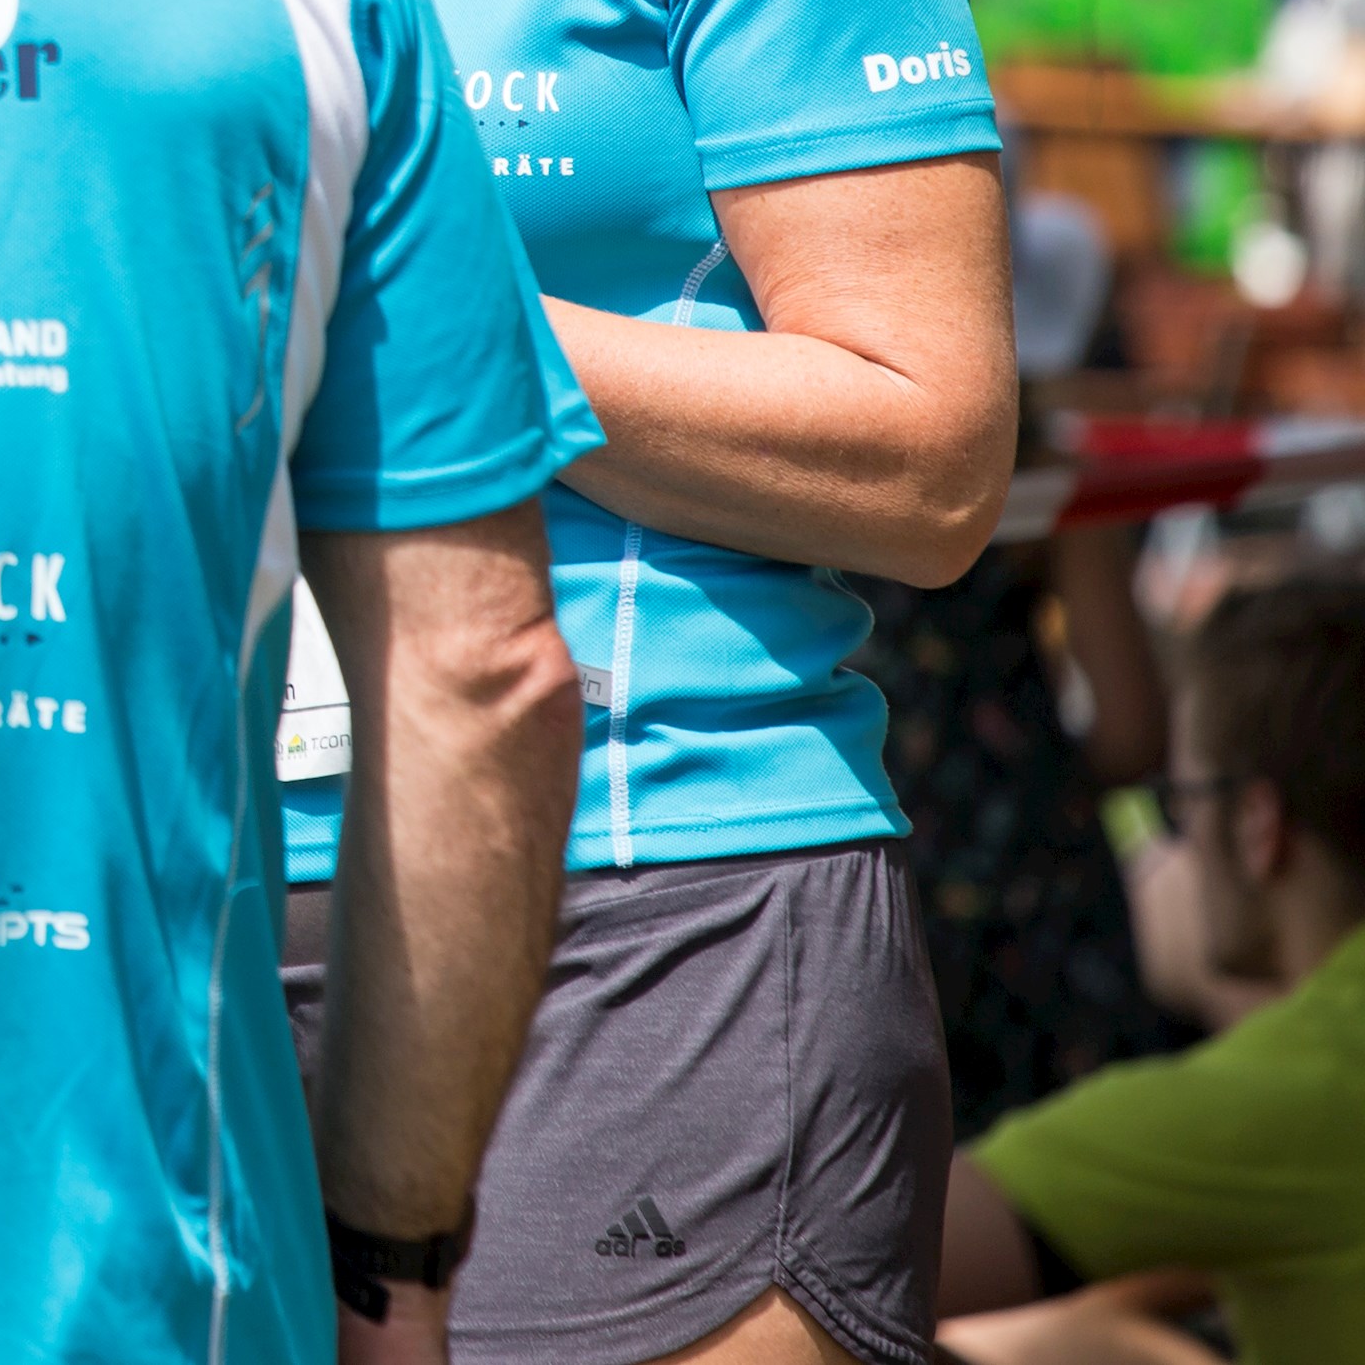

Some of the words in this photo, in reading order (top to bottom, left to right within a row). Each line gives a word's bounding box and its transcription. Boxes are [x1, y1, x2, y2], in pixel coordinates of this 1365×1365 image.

[863, 41, 972, 93] Doris
[463, 70, 561, 113] OCK
[492, 153, 575, 177] RÄTE
